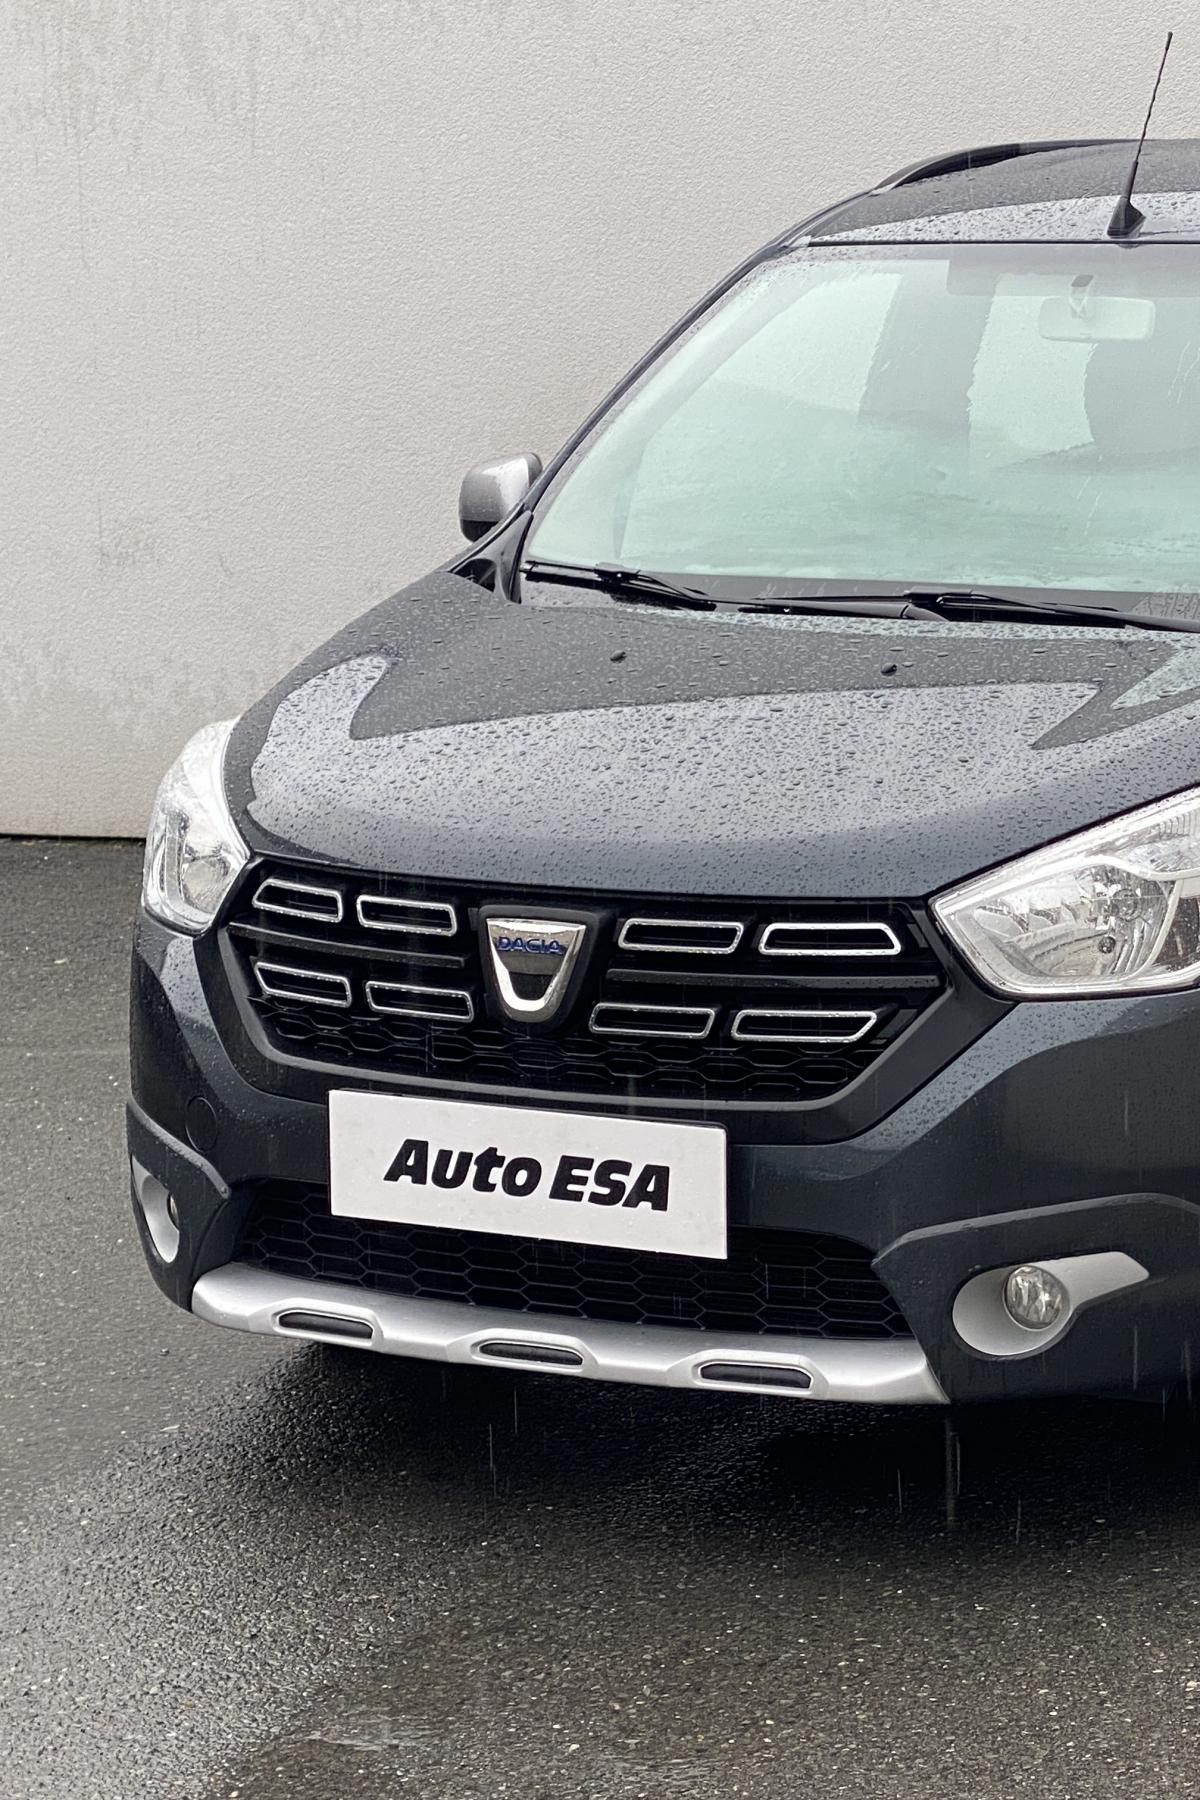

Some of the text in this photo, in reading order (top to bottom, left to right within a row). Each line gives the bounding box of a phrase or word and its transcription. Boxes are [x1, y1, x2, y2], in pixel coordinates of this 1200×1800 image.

[497, 936, 564, 954] DACIA
[384, 1138, 671, 1211] Auto ESA
